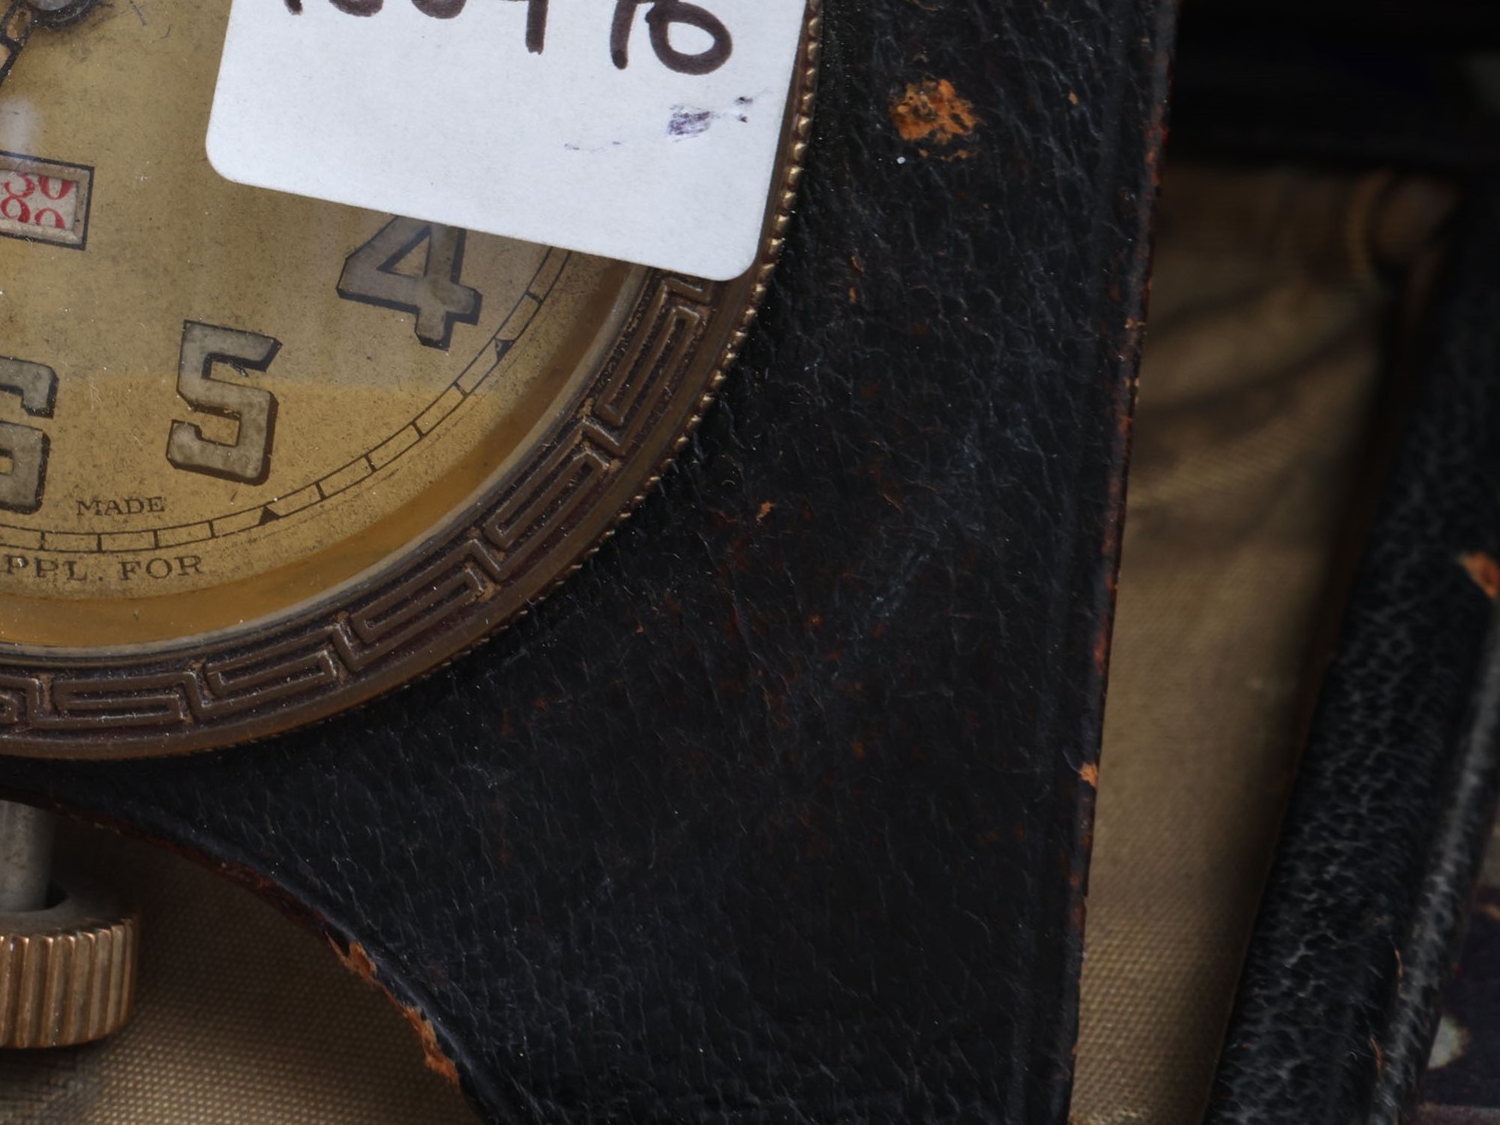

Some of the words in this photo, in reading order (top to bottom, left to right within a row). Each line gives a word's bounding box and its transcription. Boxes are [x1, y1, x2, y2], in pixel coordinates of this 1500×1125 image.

[336, 215, 483, 351] 4
[165, 319, 284, 487] 5
[75, 496, 166, 517] MADE
[117, 554, 203, 581] FOR
